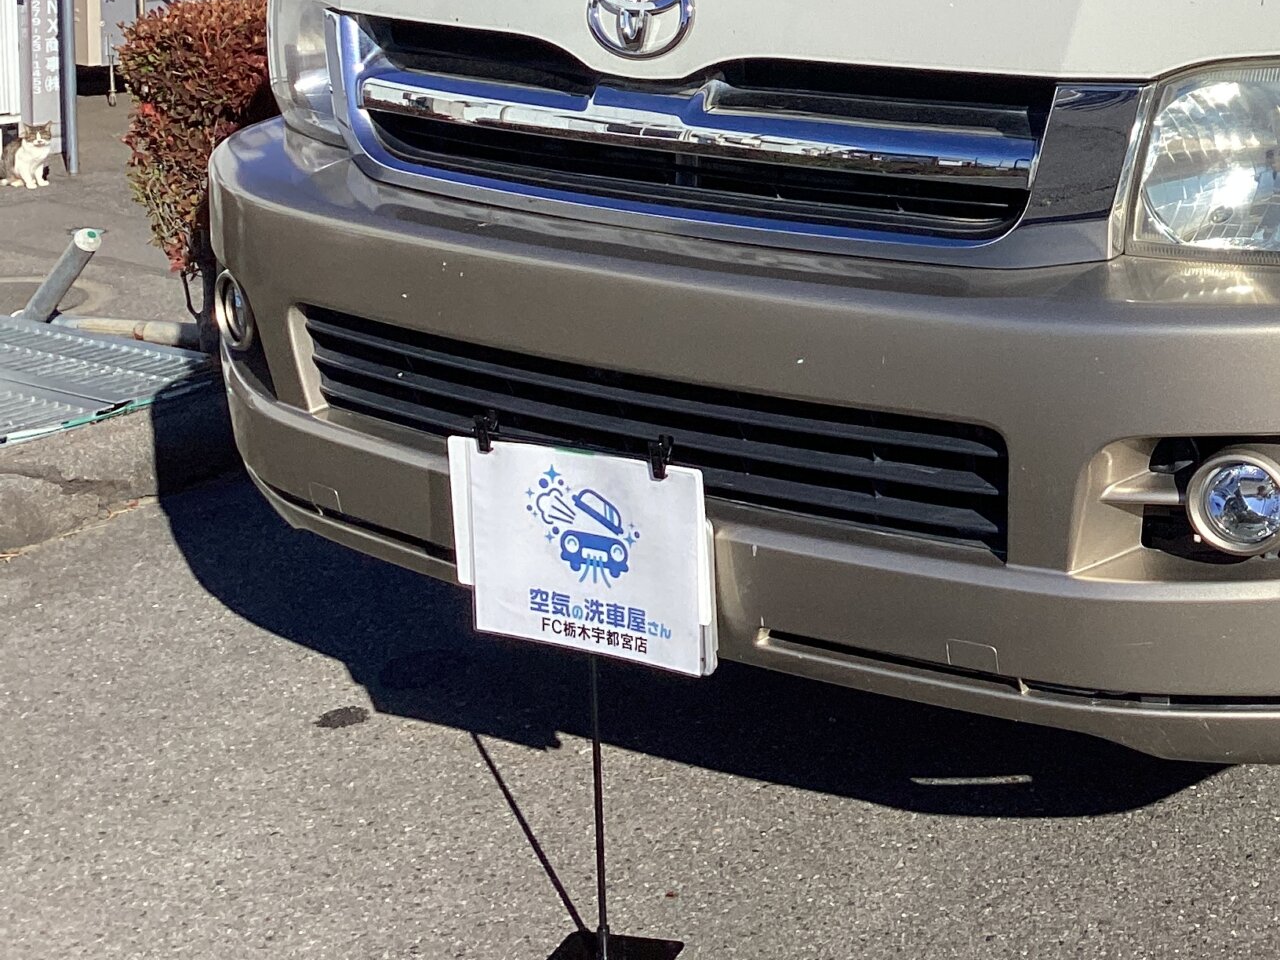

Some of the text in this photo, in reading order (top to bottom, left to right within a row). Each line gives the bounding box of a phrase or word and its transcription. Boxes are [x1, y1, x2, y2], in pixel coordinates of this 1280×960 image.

[530, 588, 672, 639] 空気の洗車屋さん
[542, 617, 648, 654] FC栃木宇都宮店
